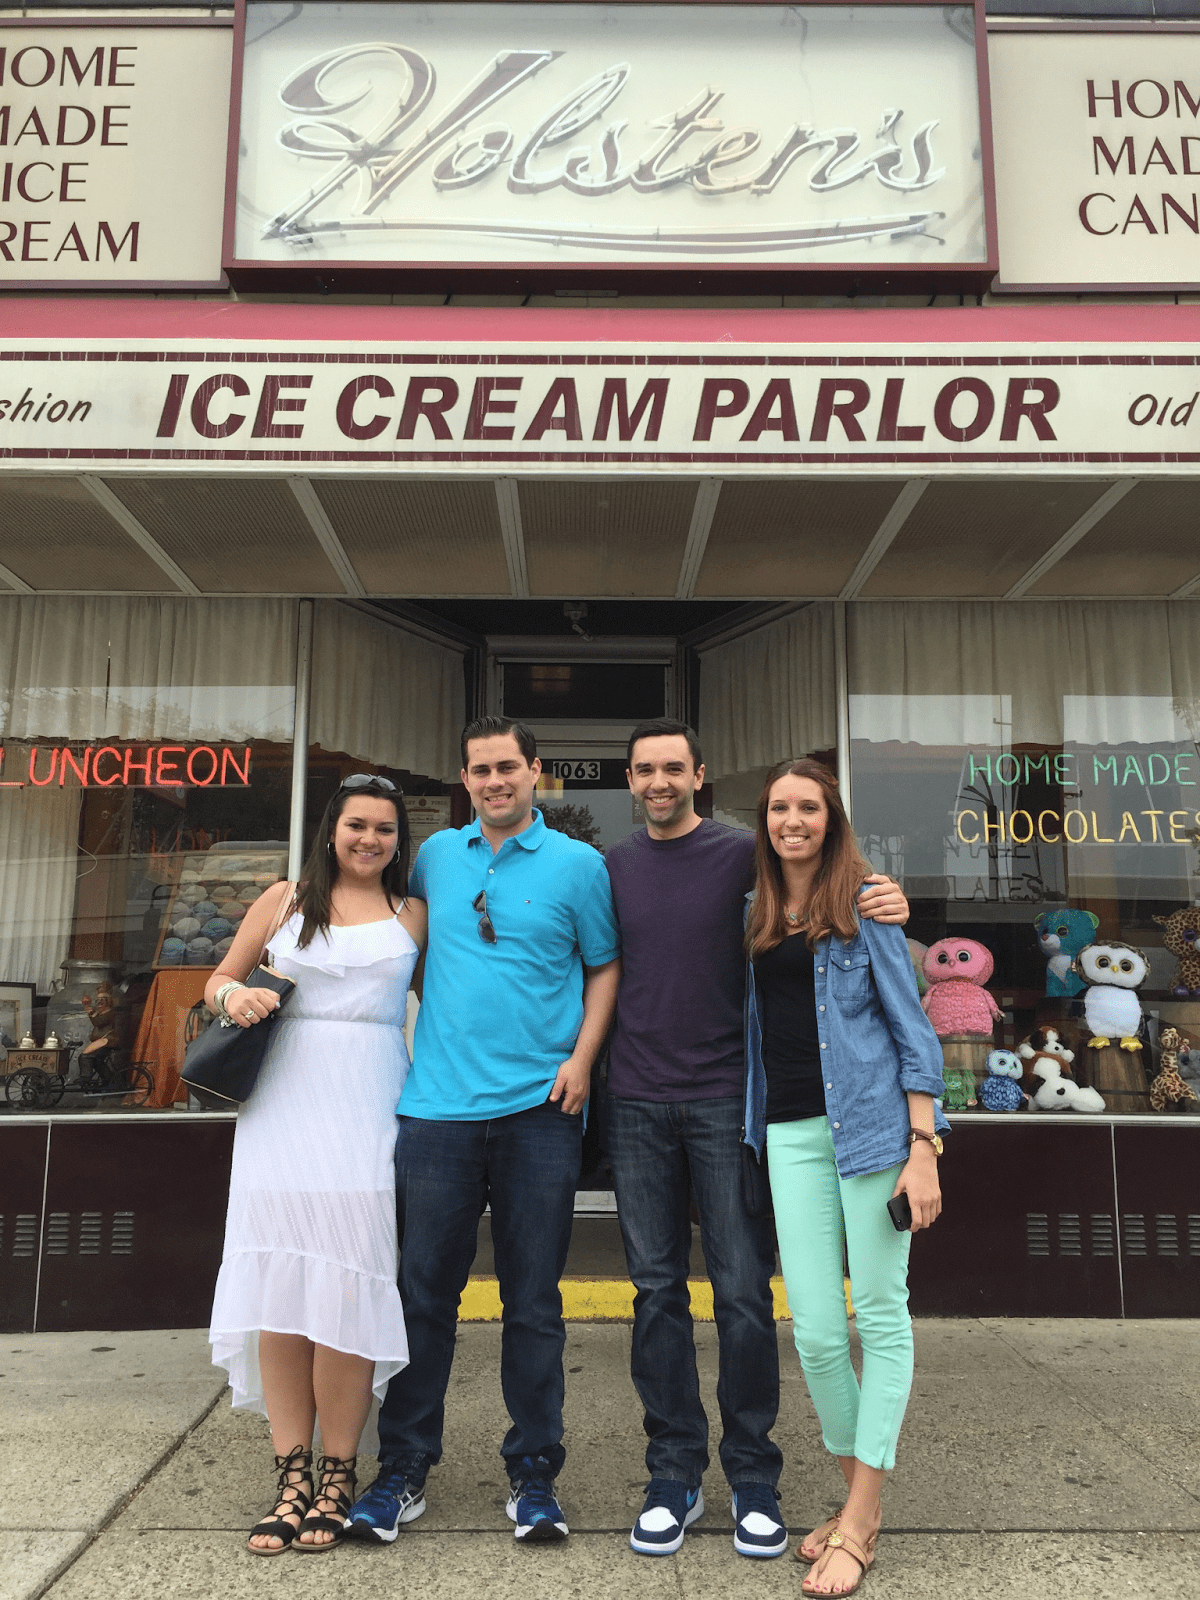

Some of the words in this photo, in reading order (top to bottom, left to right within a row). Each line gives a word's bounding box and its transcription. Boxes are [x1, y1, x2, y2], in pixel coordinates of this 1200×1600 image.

[0, 45, 138, 88] OME
[0, 105, 131, 147] ADE
[262, 40, 948, 238] Holsten's
[2, 161, 89, 203] ICE
[1078, 192, 1200, 236] CAN
[156, 373, 314, 440] ICE
[335, 374, 671, 442] CREAM
[692, 376, 1061, 443] PARLOR
[1128, 391, 1200, 427] Old
[553, 762, 600, 779] 1063
[969, 752, 1077, 786] HOME
[1093, 753, 1197, 787] MADE
